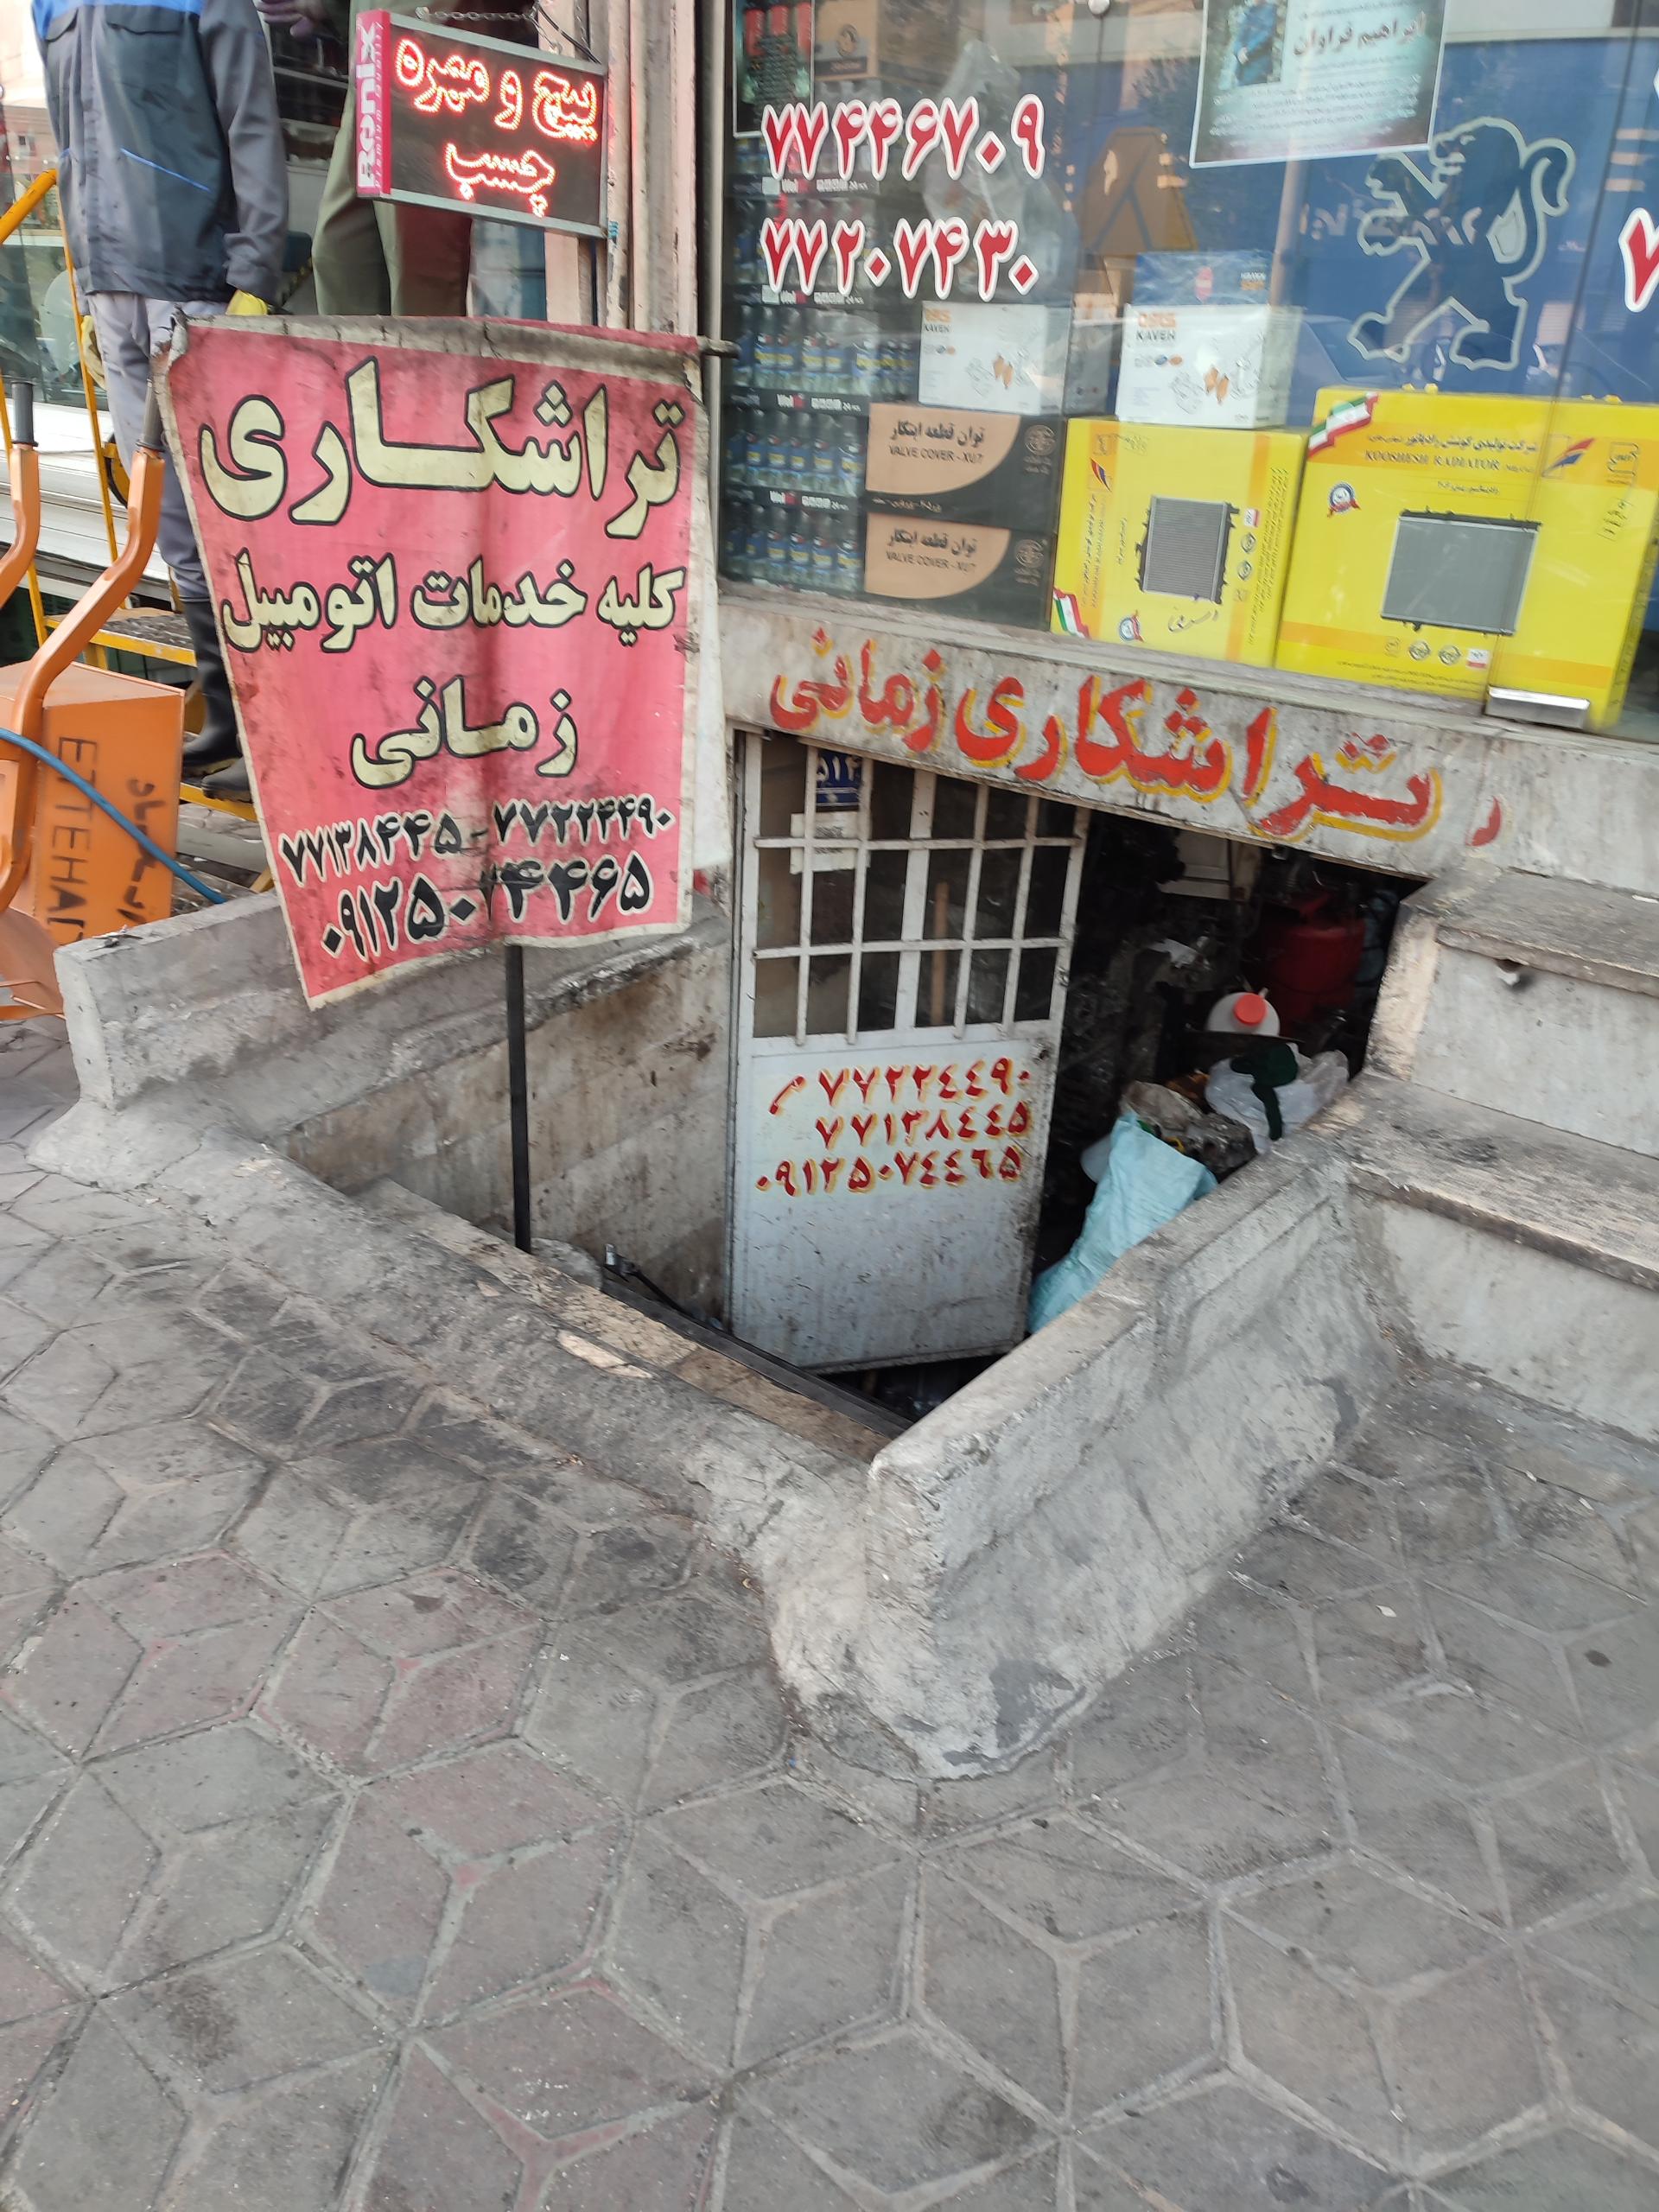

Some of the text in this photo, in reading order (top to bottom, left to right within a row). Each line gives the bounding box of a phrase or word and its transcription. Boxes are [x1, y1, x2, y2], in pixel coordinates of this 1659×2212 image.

[356, 22, 377, 188] Ronix
[395, 38, 598, 142] پیچ و مهره
[443, 142, 556, 217] چسب
[761, 93, 1046, 181] ۷۷۴۴۶۷۰۹
[760, 217, 1039, 302] ۷۷۲۰۷۴۳۰
[199, 355, 685, 539] تراشکاری
[888, 444, 918, 458] VALVE
[921, 447, 955, 461] COVER
[925, 422, 955, 440] قطعه
[410, 554, 588, 630] خدمات
[886, 550, 913, 564] VALVE
[918, 554, 950, 569] COVER
[597, 563, 686, 647] کلیه
[350, 674, 577, 790] زمانی
[954, 675, 1444, 842] تراشکاری
